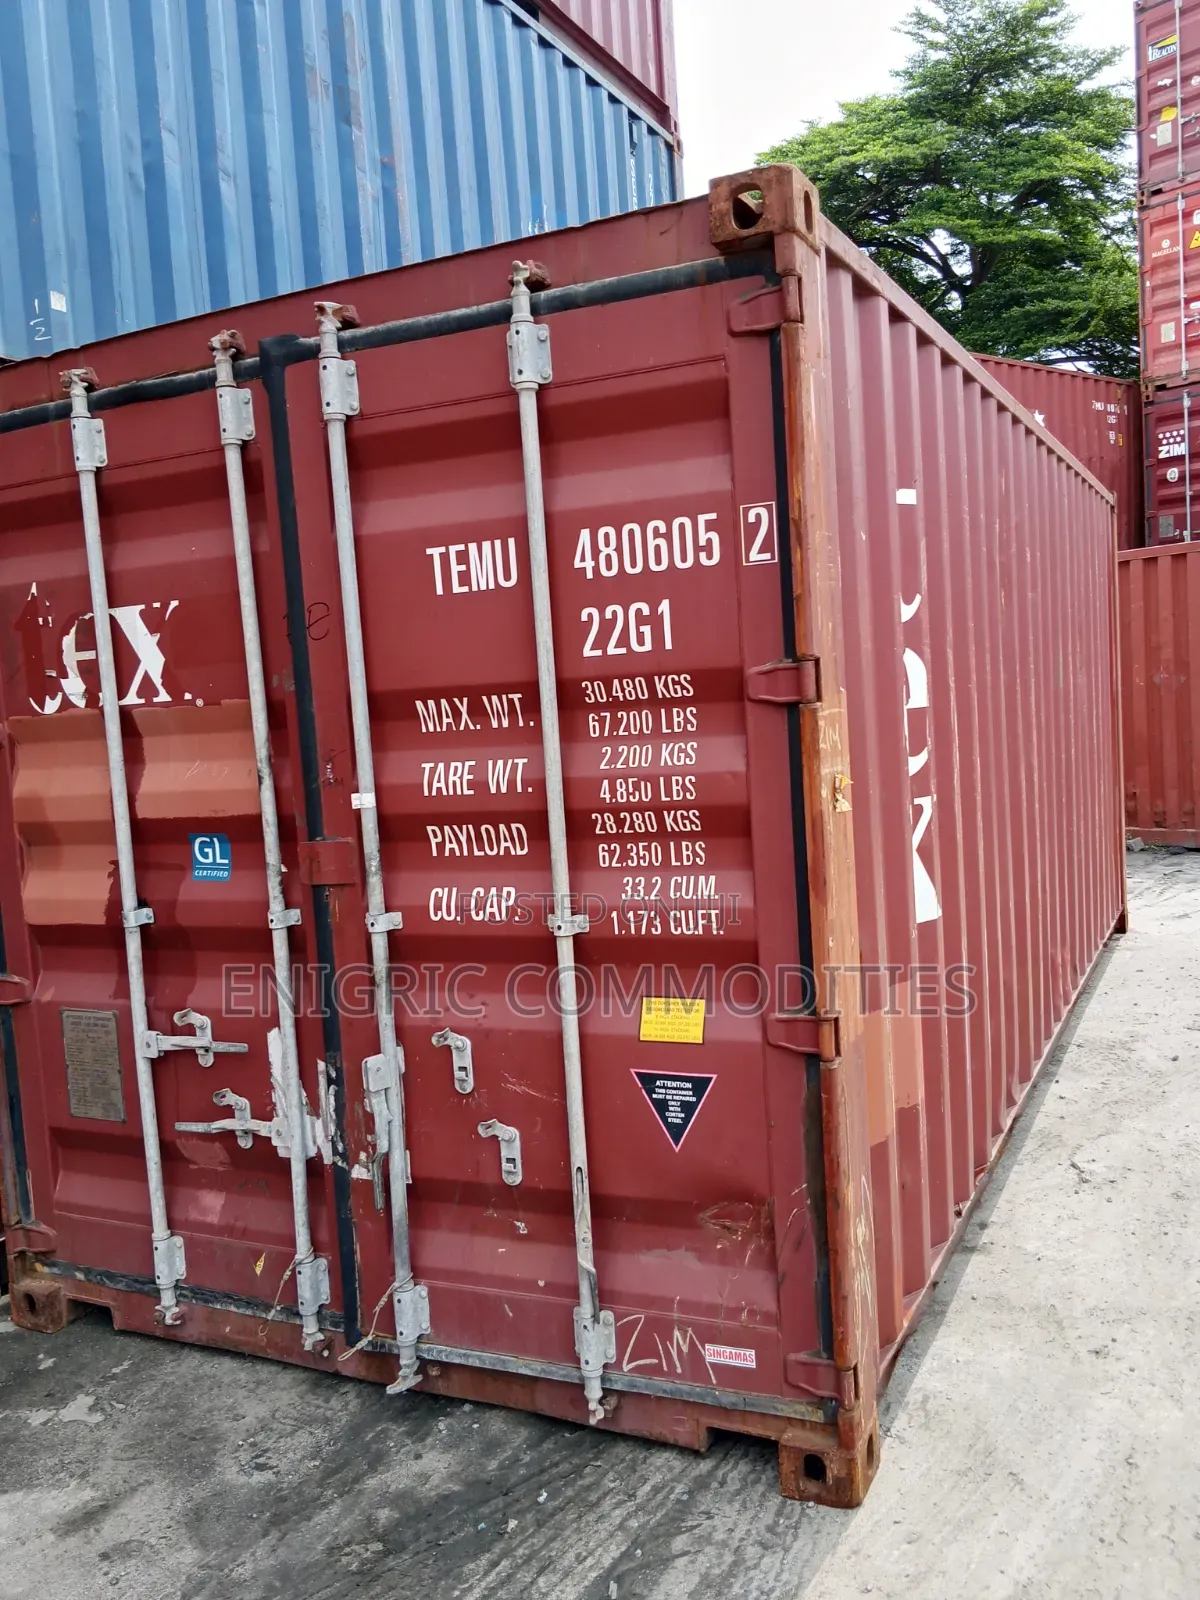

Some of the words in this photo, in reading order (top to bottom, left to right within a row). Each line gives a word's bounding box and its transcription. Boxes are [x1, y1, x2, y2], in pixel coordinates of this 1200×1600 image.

[1152, 245, 1180, 258] MAGELLAN
[1158, 443, 1186, 459] ZIM
[426, 537, 519, 596] TEMU
[573, 512, 721, 580] 480605
[747, 506, 772, 562] 2
[580, 598, 674, 658] 22G1
[654, 673, 694, 699] KGS
[415, 696, 481, 733] MAX.
[482, 693, 535, 730] WT.
[660, 706, 698, 734] LBS
[660, 741, 698, 767] KGS
[421, 760, 476, 797] TARE
[487, 758, 533, 794] WT.
[659, 775, 697, 801] LBS
[663, 809, 702, 832] KGS
[194, 836, 229, 864] GL
[426, 822, 529, 857] PAYLOAD
[669, 841, 706, 866] LBS
[194, 869, 229, 878] CERTIFIED
[621, 876, 662, 900] 33.2
[429, 887, 461, 921] CU.
[655, 1080, 692, 1089] ATTENTION
[617, 1313, 717, 1384] ZIM
[706, 1346, 755, 1364] SINGAMAS
